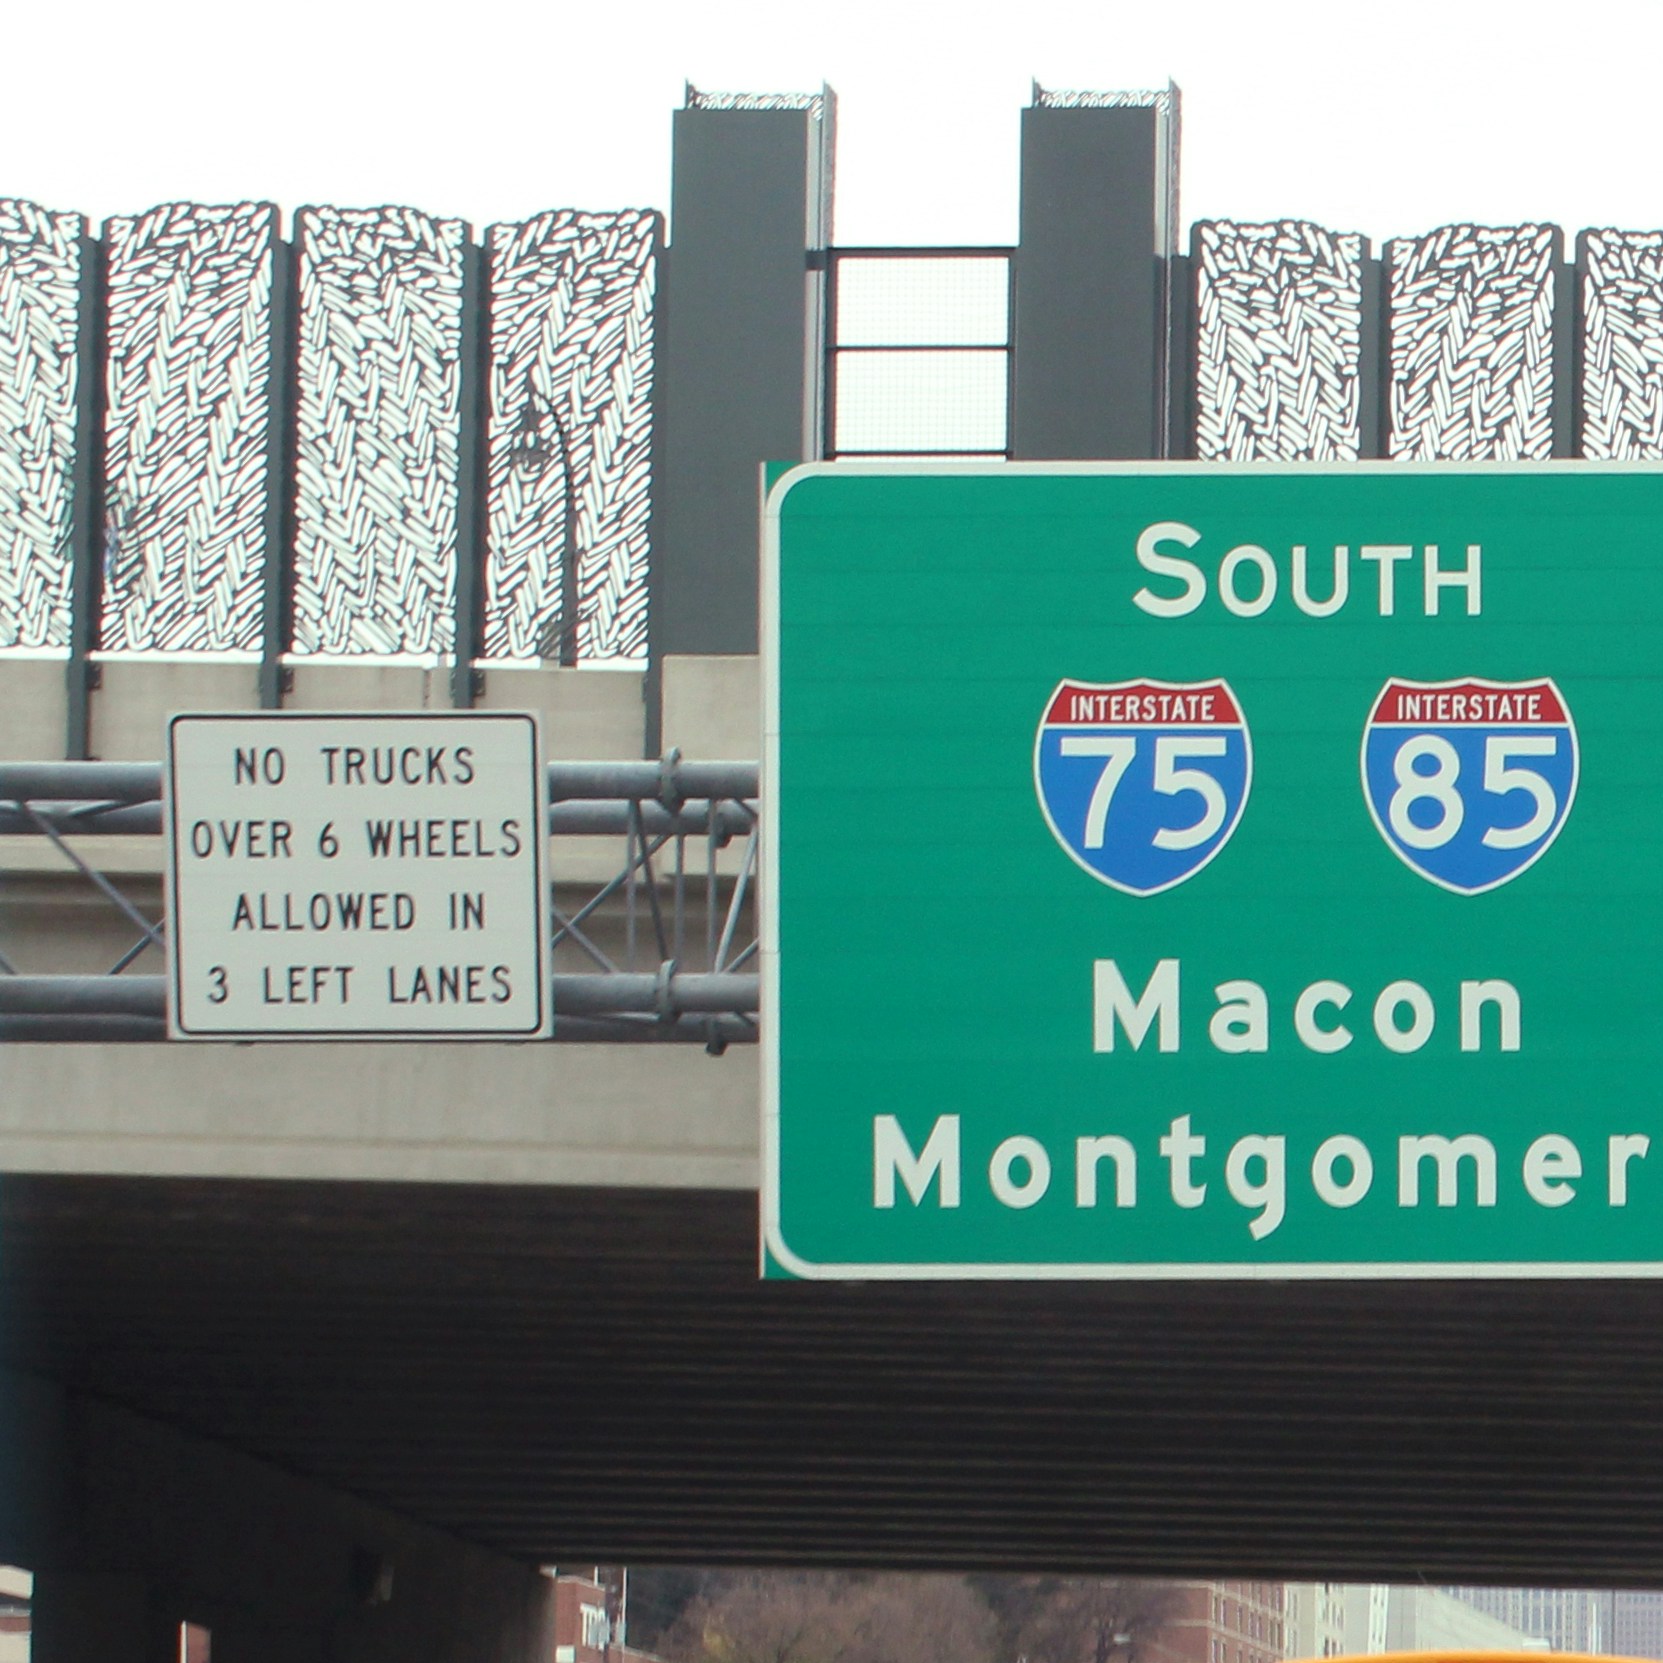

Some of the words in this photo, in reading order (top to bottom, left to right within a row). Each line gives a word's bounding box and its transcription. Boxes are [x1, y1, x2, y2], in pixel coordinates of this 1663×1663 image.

[1133, 522, 1481, 617] SOUTH
[1069, 694, 1216, 722] INTERSTATE
[1396, 693, 1543, 721] INTERSTATE
[233, 746, 286, 786] NO
[320, 746, 477, 786] TRUCKS
[1059, 736, 1228, 851] 75
[1388, 734, 1558, 850] 85
[190, 819, 293, 860] OVER
[317, 819, 340, 859] 6
[365, 818, 523, 858] WHEELS
[231, 892, 416, 931] ALLOWED
[449, 892, 486, 931] IN
[207, 965, 230, 1004] 3
[262, 965, 354, 1004] LEFT
[388, 965, 514, 1004] LANES
[1094, 959, 1520, 1053] Macon
